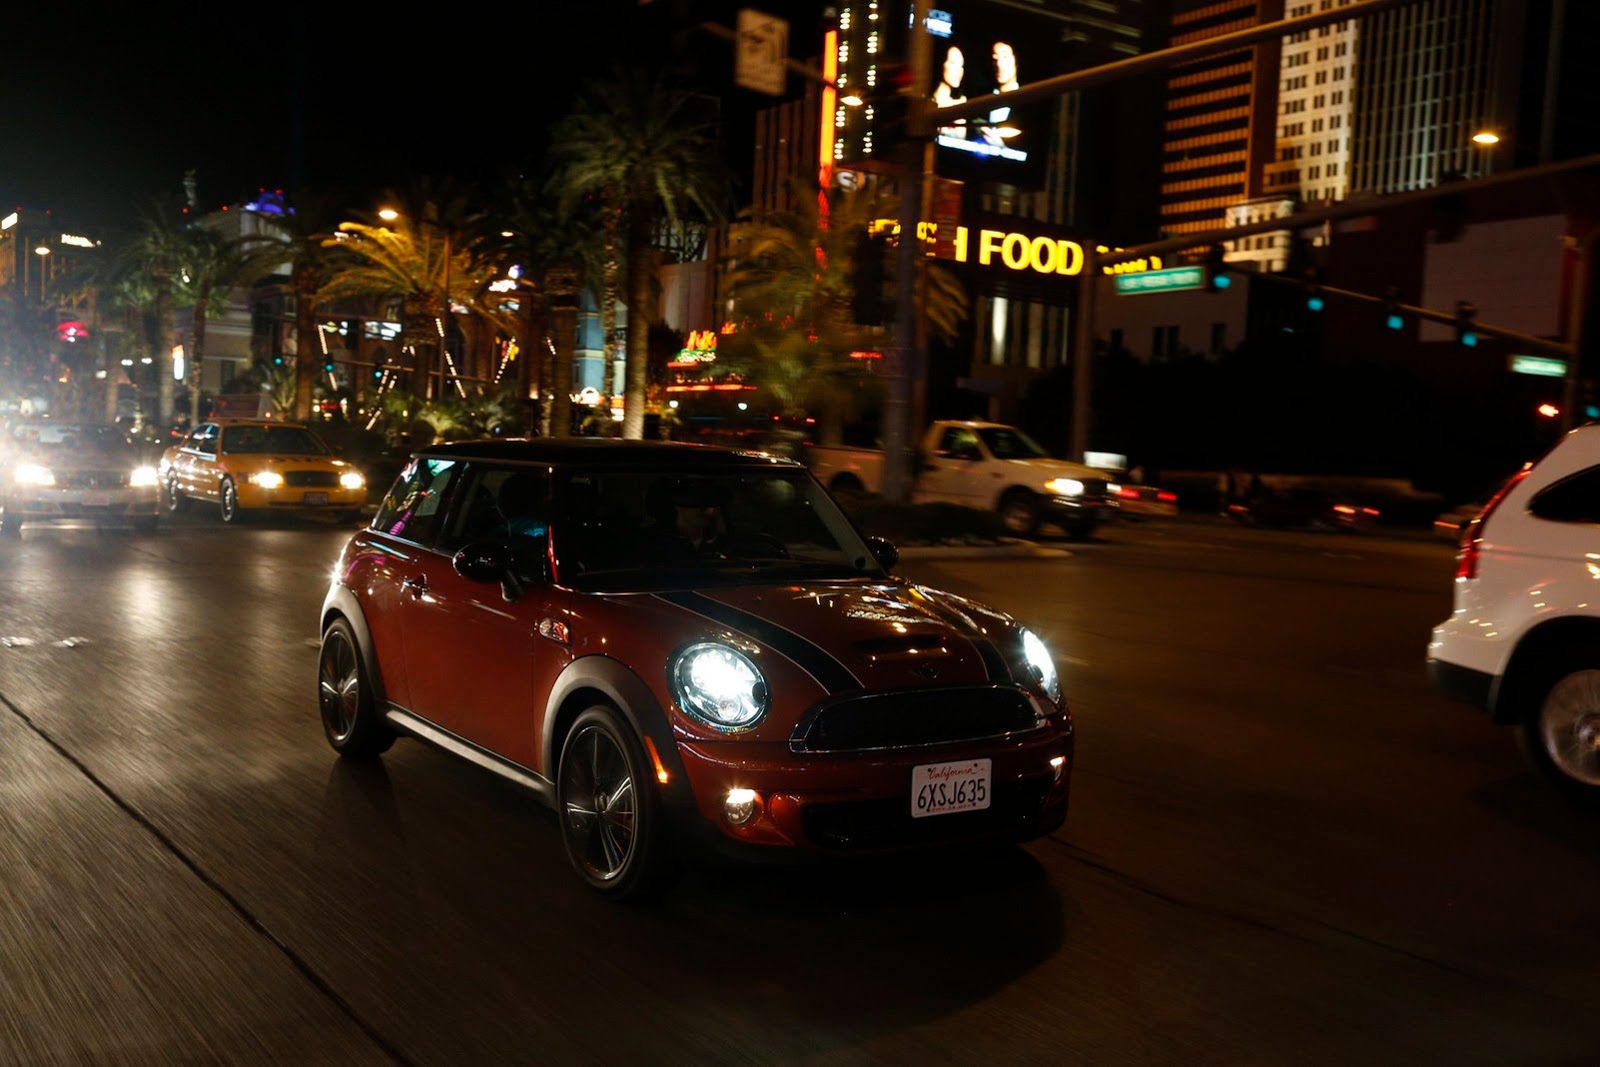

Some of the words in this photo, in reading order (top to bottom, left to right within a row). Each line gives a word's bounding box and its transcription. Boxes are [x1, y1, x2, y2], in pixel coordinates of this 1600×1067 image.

[979, 229, 1084, 276] FOOD
[929, 766, 976, 781] California
[917, 778, 986, 809] 6XSJ635
